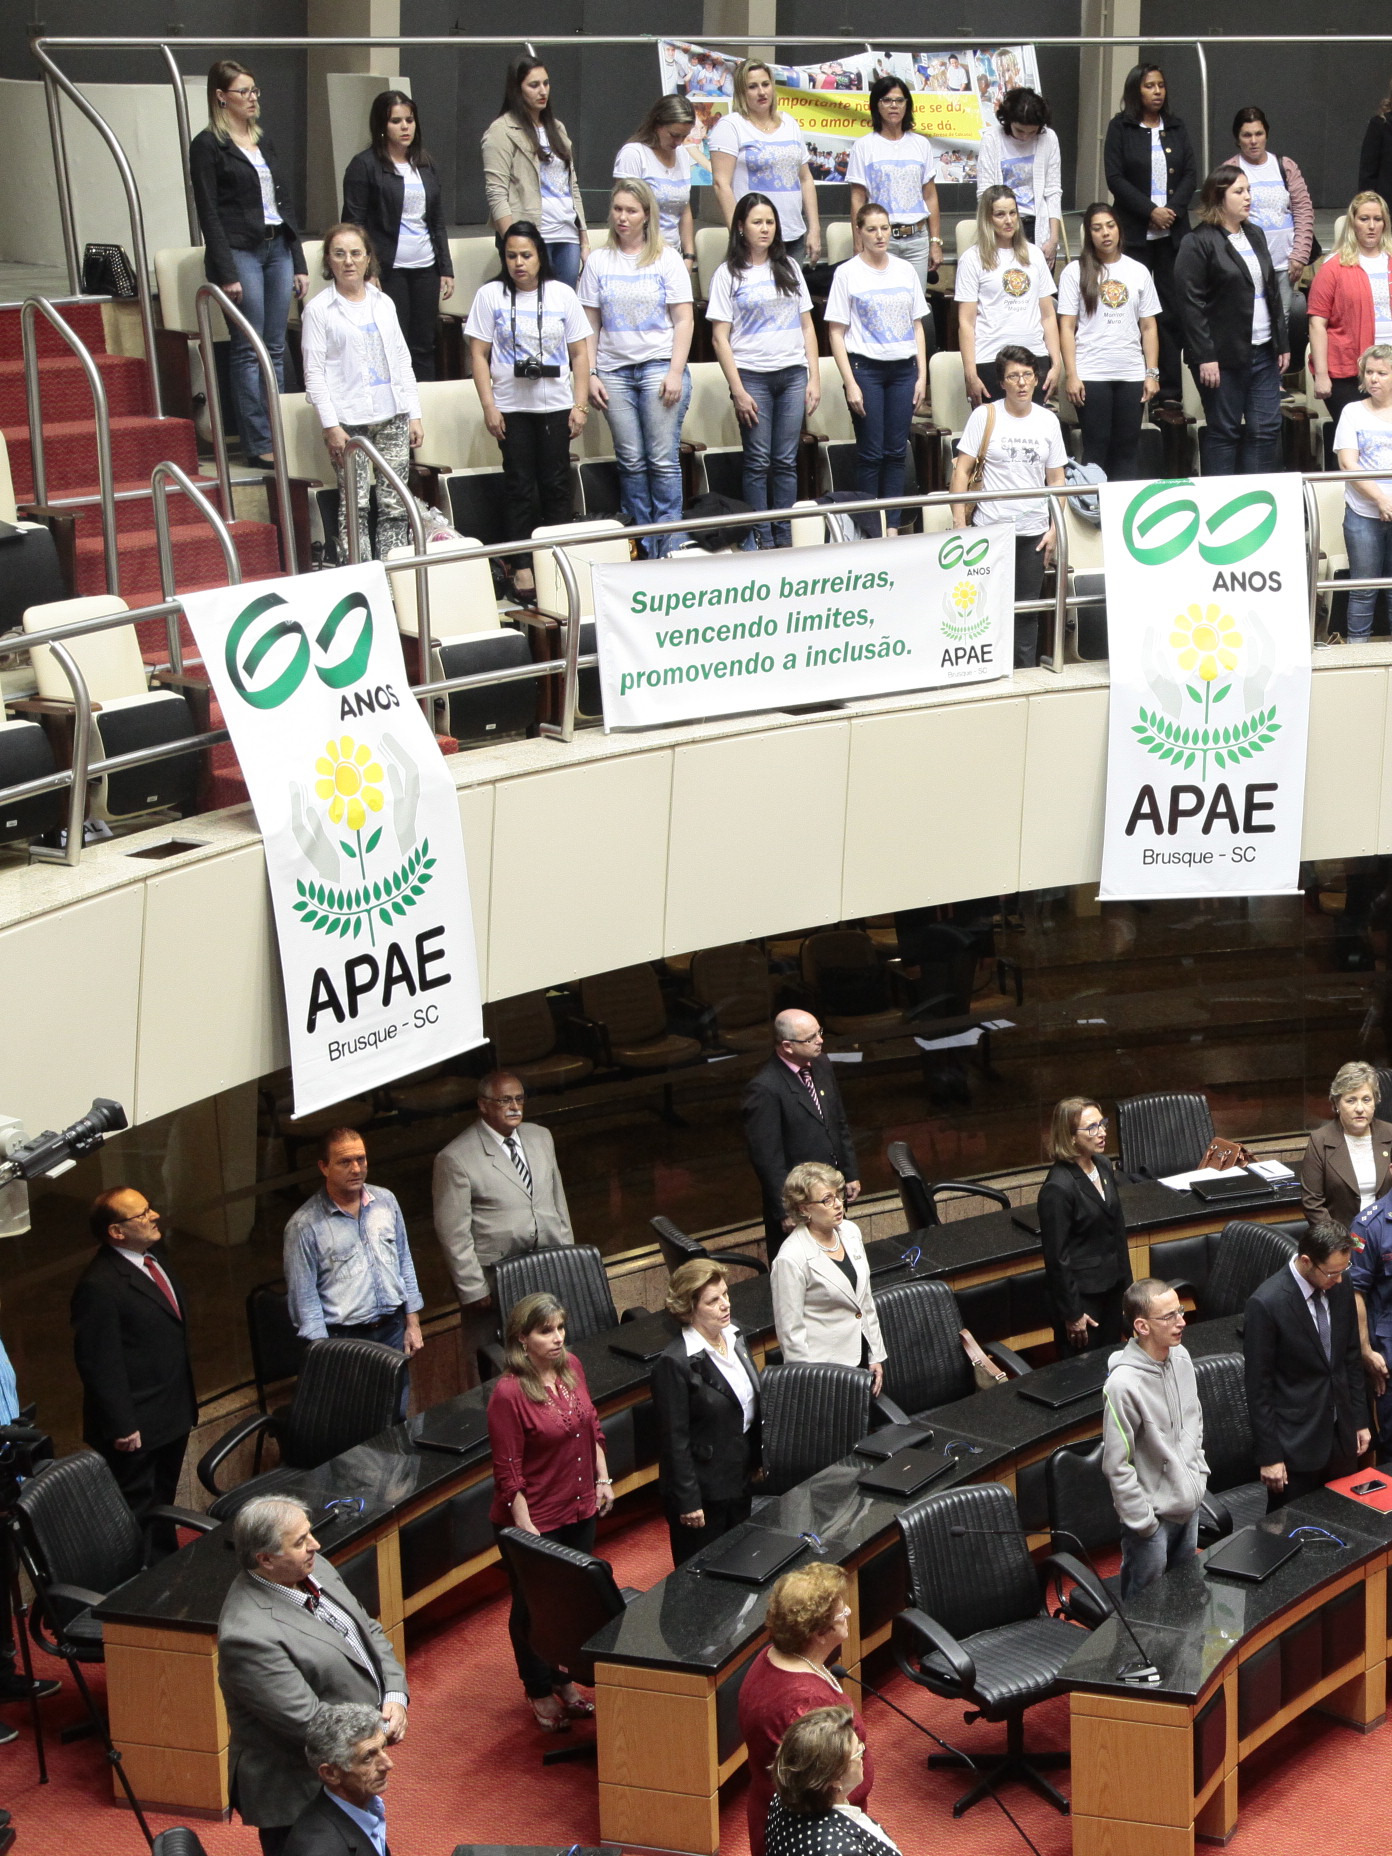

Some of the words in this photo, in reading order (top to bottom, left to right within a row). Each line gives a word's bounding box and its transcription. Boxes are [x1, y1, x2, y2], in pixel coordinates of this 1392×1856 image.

[777, 97, 851, 111] mportante
[855, 100, 872, 111] nã
[929, 104, 942, 113] se
[808, 118, 817, 128] o
[820, 118, 857, 128] amor
[920, 122, 934, 131] se
[937, 120, 956, 131] dá.
[1122, 478, 1278, 566] 60
[938, 535, 990, 570] 60
[966, 567, 991, 577] ANOS
[1212, 570, 1282, 593] ANOS
[630, 579, 771, 616] Superando
[779, 569, 895, 599] barreiras,
[655, 615, 778, 648] vencendo
[786, 607, 875, 634] limites,
[225, 591, 374, 710] 60
[620, 652, 775, 696] promovendo
[782, 652, 797, 671] a
[805, 635, 913, 668] inclusão.
[941, 644, 993, 668] APAE
[947, 669, 973, 679] Brusque
[978, 667, 988, 675] SC
[340, 684, 400, 721] ANOS
[1125, 782, 1279, 836] APAE
[1142, 848, 1214, 868] Brusque
[1231, 846, 1257, 863] SC
[307, 925, 452, 1034] APAE
[328, 1024, 398, 1062] Brusque
[413, 1004, 439, 1029] SC
